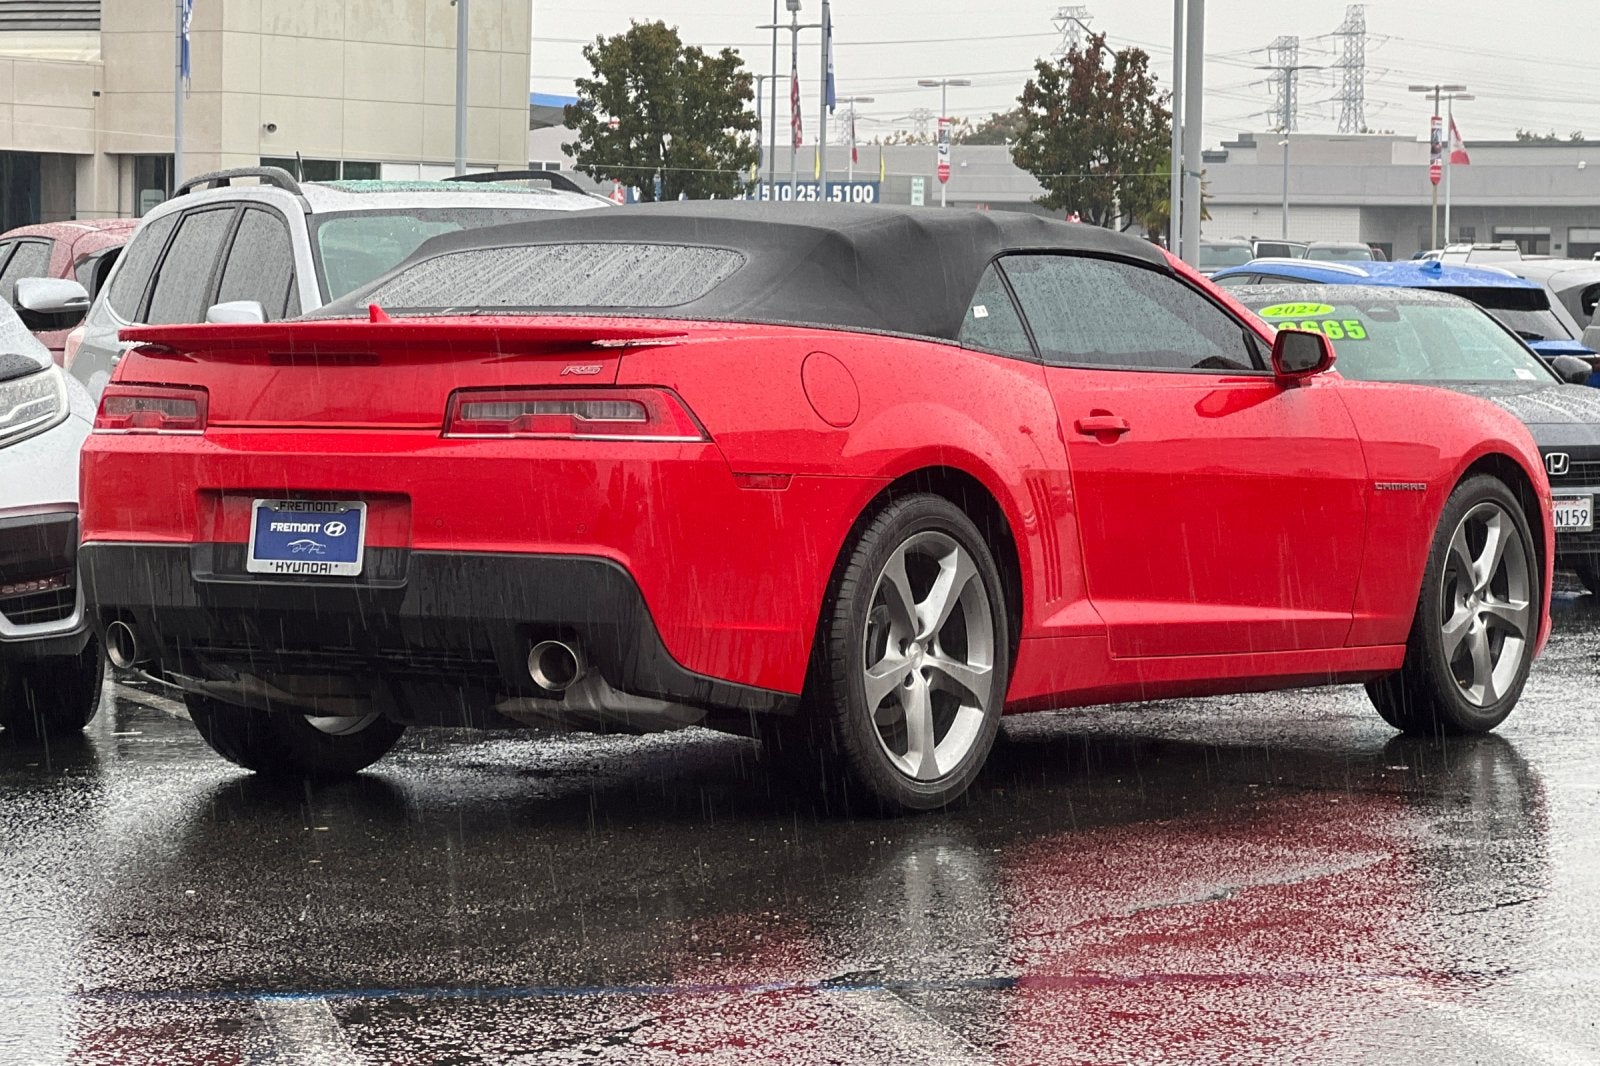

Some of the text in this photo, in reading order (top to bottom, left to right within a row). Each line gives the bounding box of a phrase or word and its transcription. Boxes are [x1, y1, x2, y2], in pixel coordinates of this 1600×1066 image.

[1271, 305, 1321, 316] 2024
[1374, 482, 1427, 491] CAMARO
[279, 500, 339, 512] FREMONT
[269, 521, 321, 534] FREMONT
[275, 561, 332, 574] HYUNDAI
